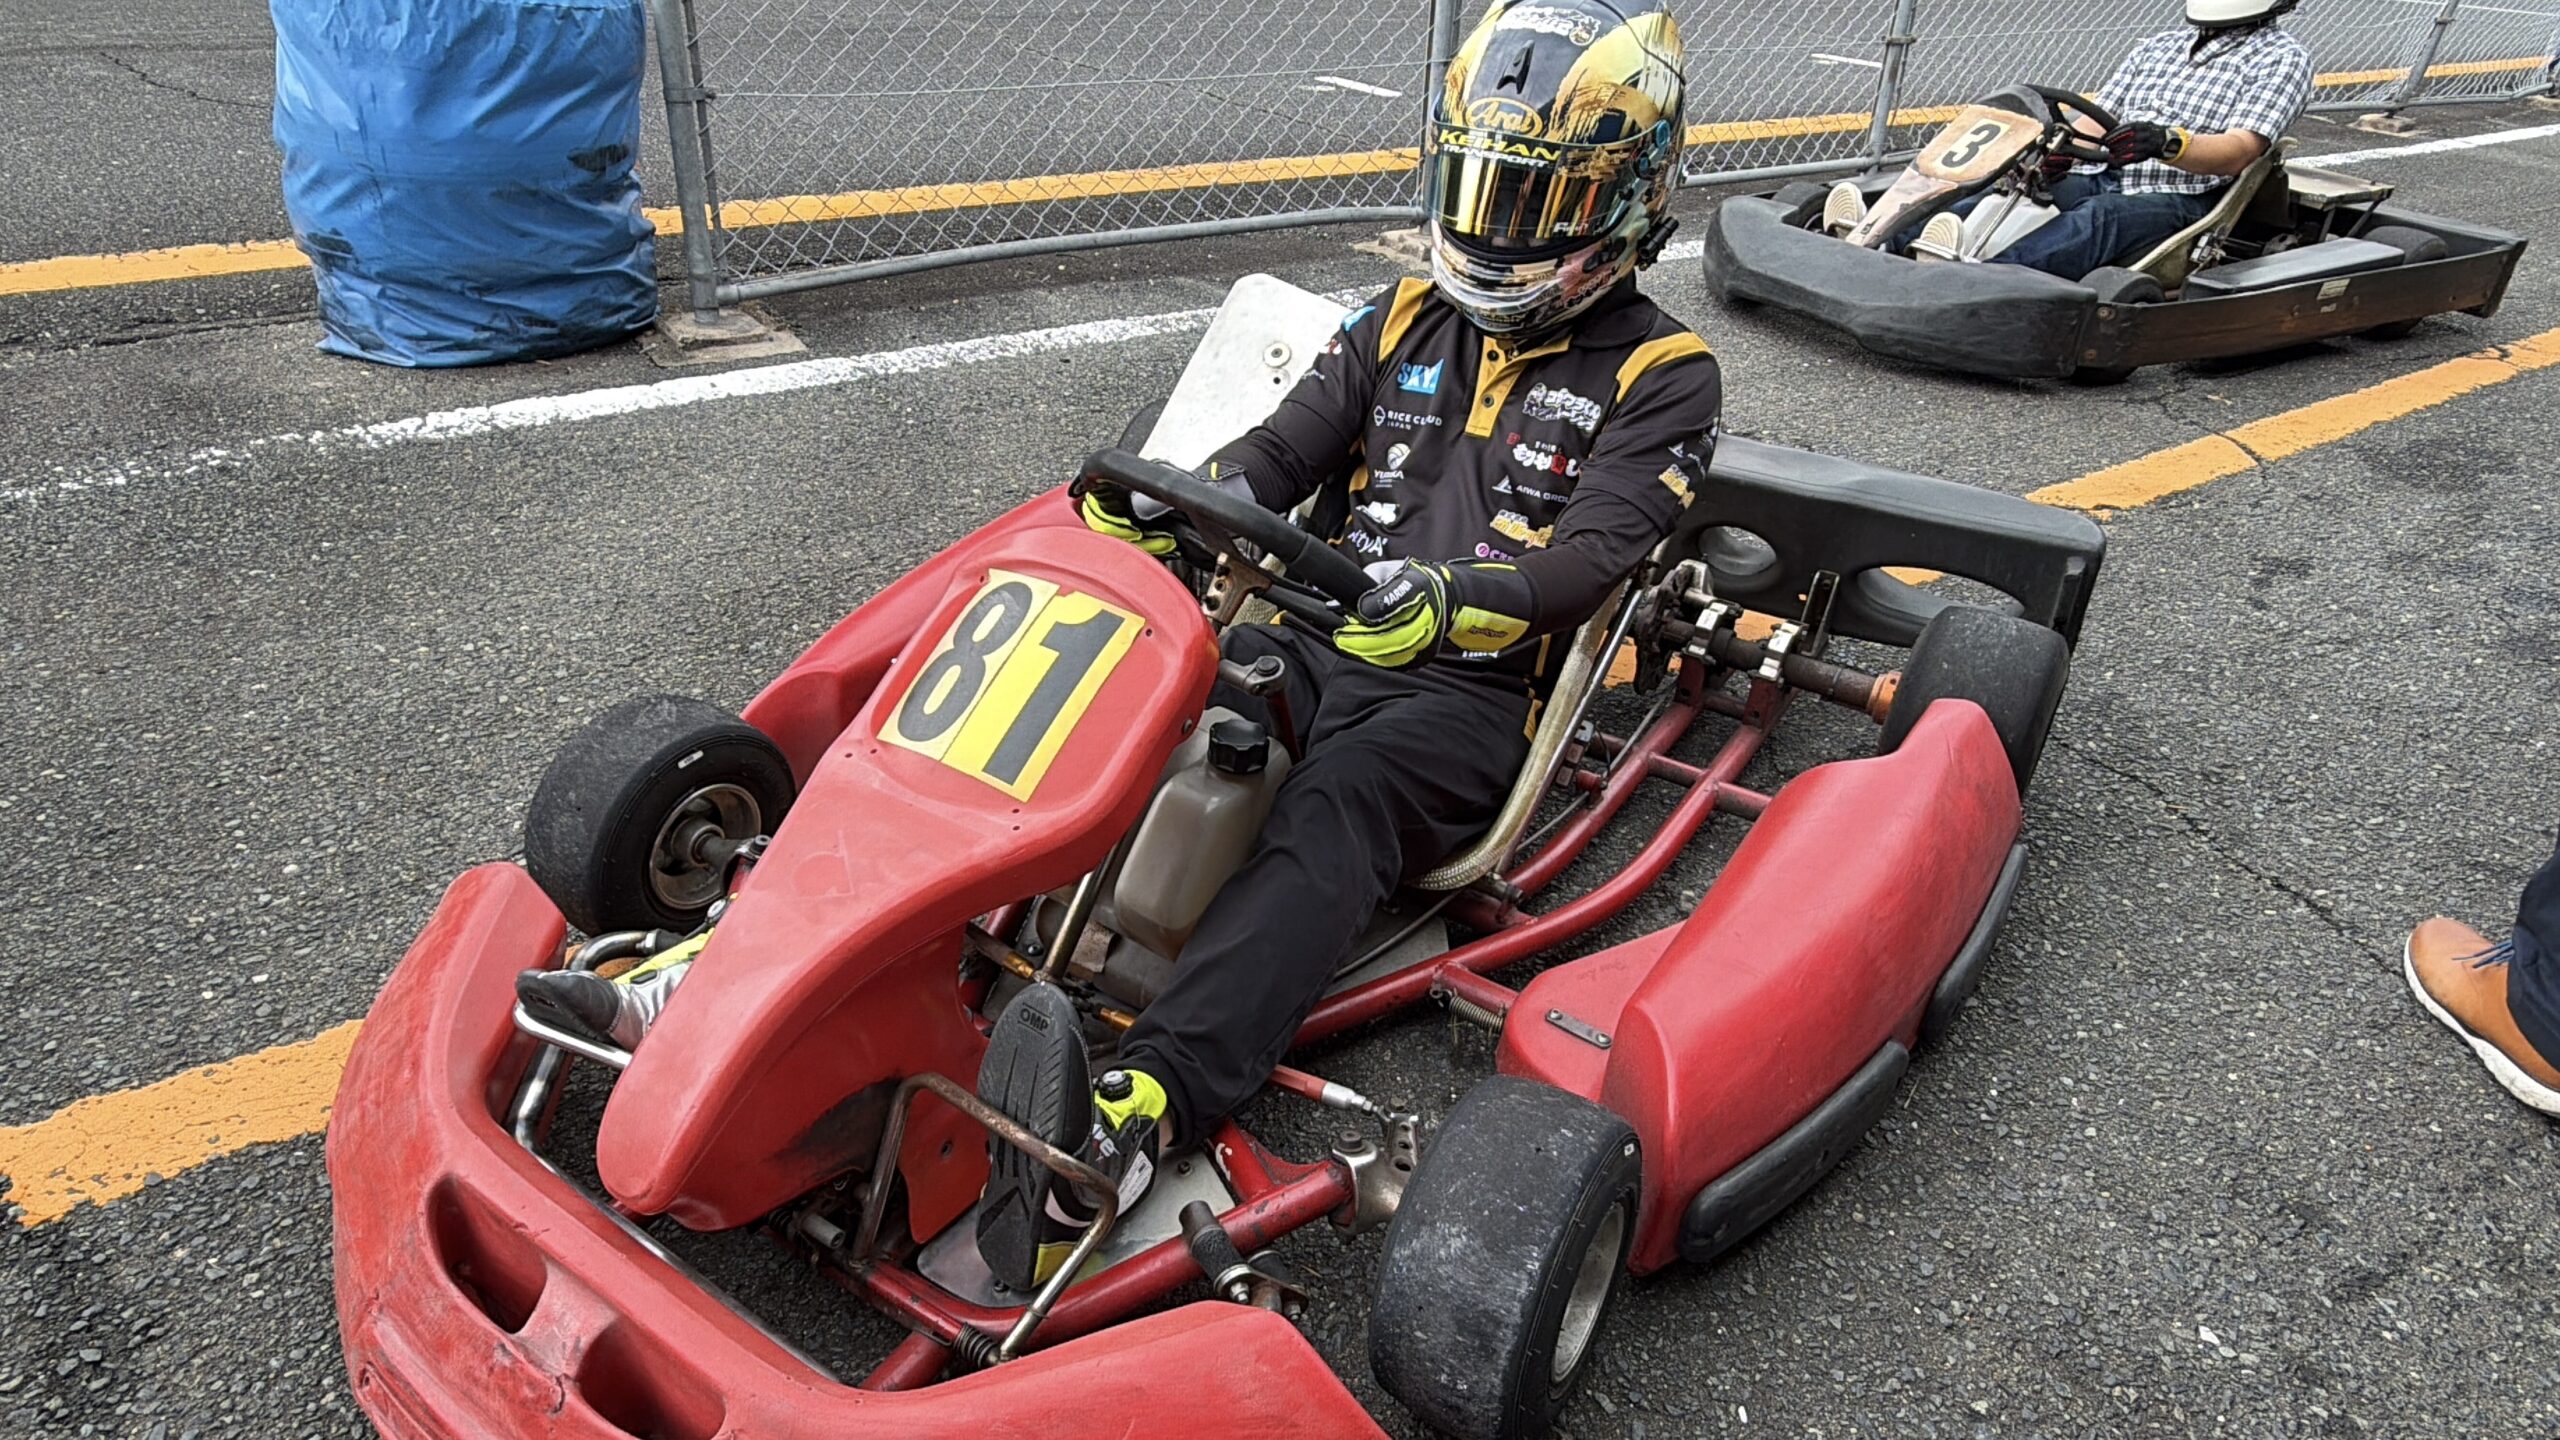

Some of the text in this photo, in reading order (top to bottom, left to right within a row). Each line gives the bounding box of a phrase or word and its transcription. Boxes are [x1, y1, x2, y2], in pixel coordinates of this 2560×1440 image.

[1471, 101, 1533, 133] Arai
[1439, 129, 1562, 161] KEIHAN
[1443, 144, 1549, 168] TRANSPORT
[1941, 123, 2001, 168] 3
[897, 581, 1124, 785] 81
[1019, 1007, 1049, 1032] OMP
